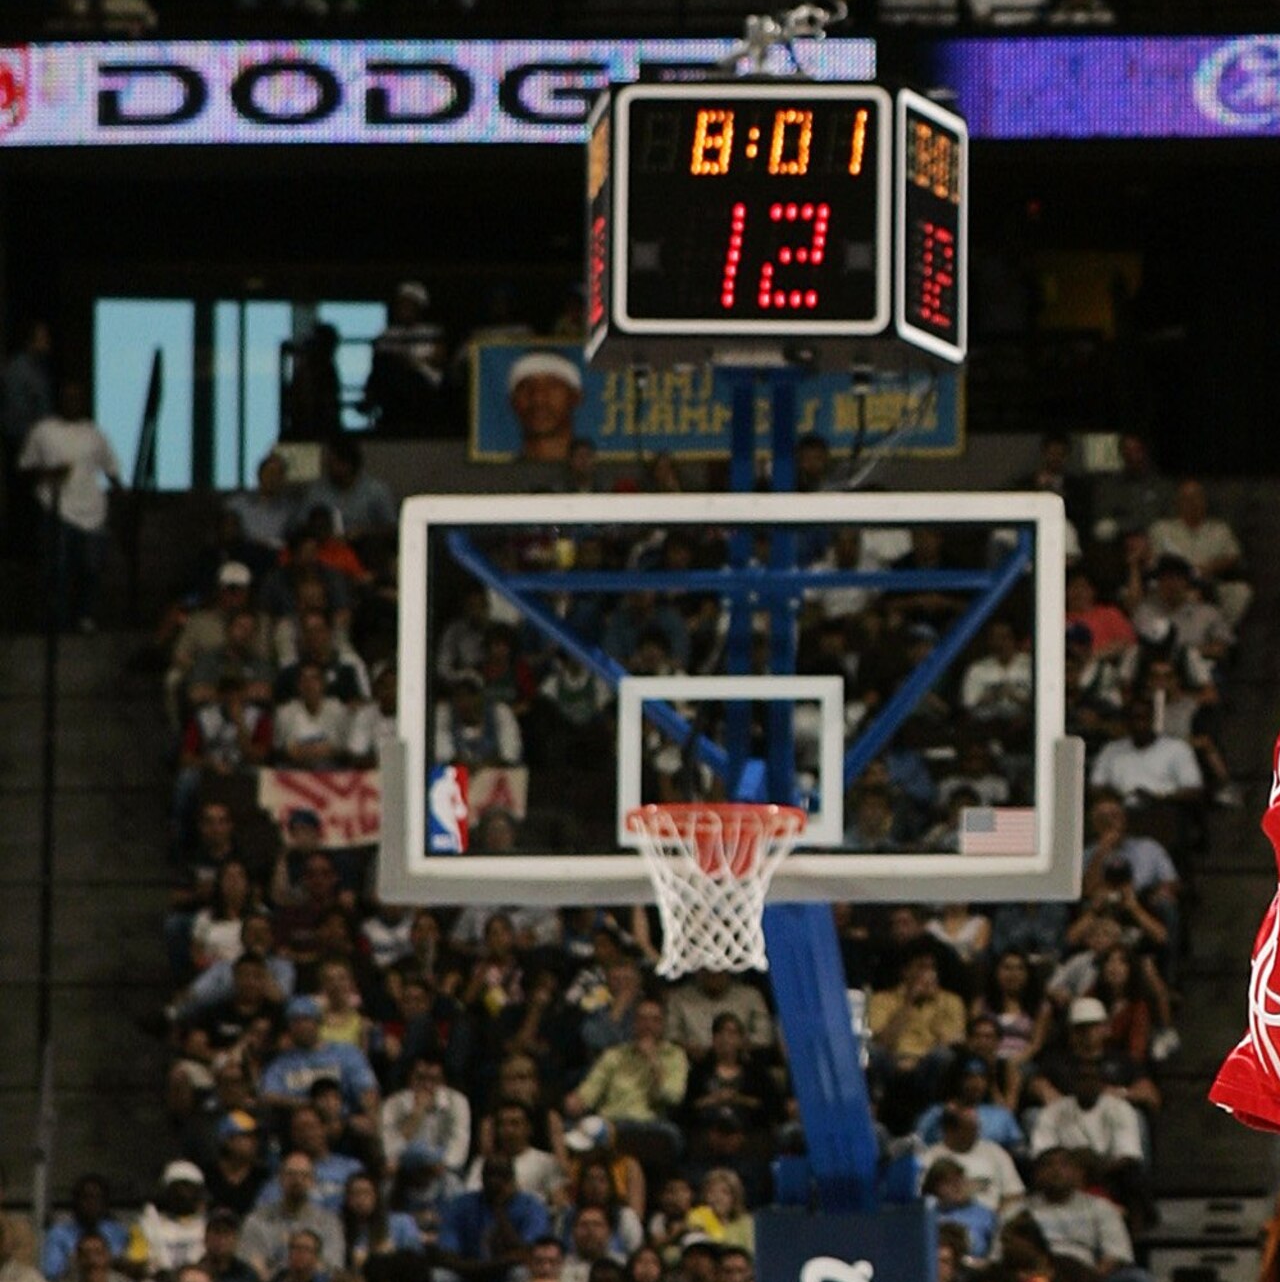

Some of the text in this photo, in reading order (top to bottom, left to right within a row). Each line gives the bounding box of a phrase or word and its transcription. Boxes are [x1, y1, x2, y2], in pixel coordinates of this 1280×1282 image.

[97, 61, 738, 127] DODG
[689, 105, 871, 178] 8:01
[719, 199, 832, 312] 12
